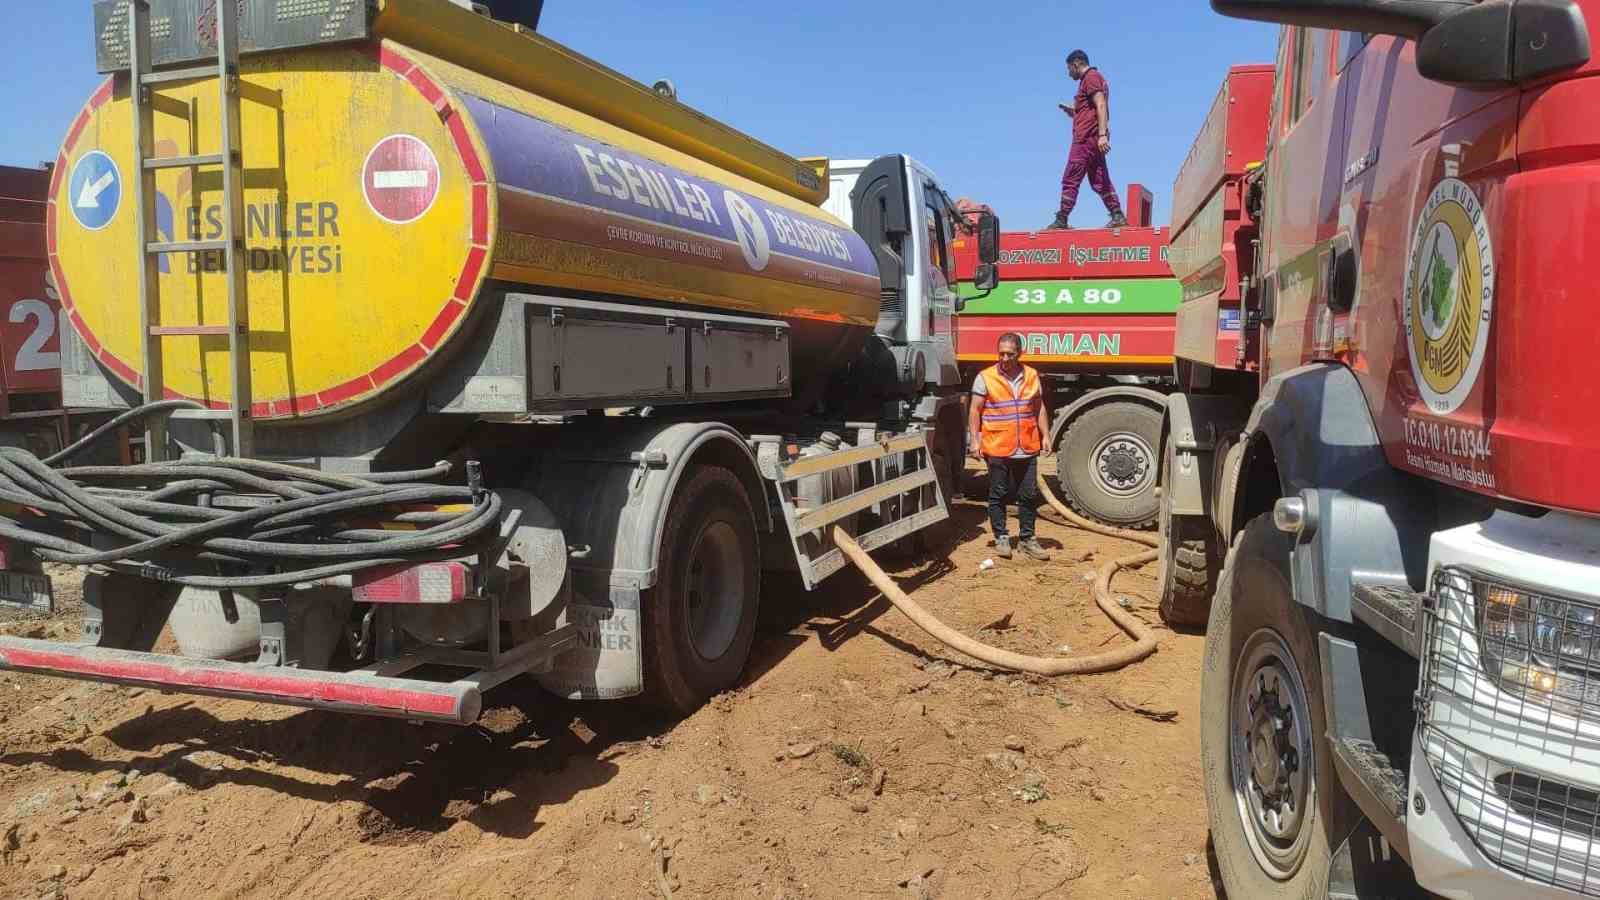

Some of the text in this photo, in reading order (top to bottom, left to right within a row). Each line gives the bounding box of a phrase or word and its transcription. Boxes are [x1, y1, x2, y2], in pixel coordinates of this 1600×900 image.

[574, 144, 721, 226] ESENLER
[184, 202, 340, 241] ESNLER
[995, 249, 1062, 265] OZYAZI
[1068, 244, 1151, 267] İŞLETME
[1014, 288, 1122, 304] 33 A 80
